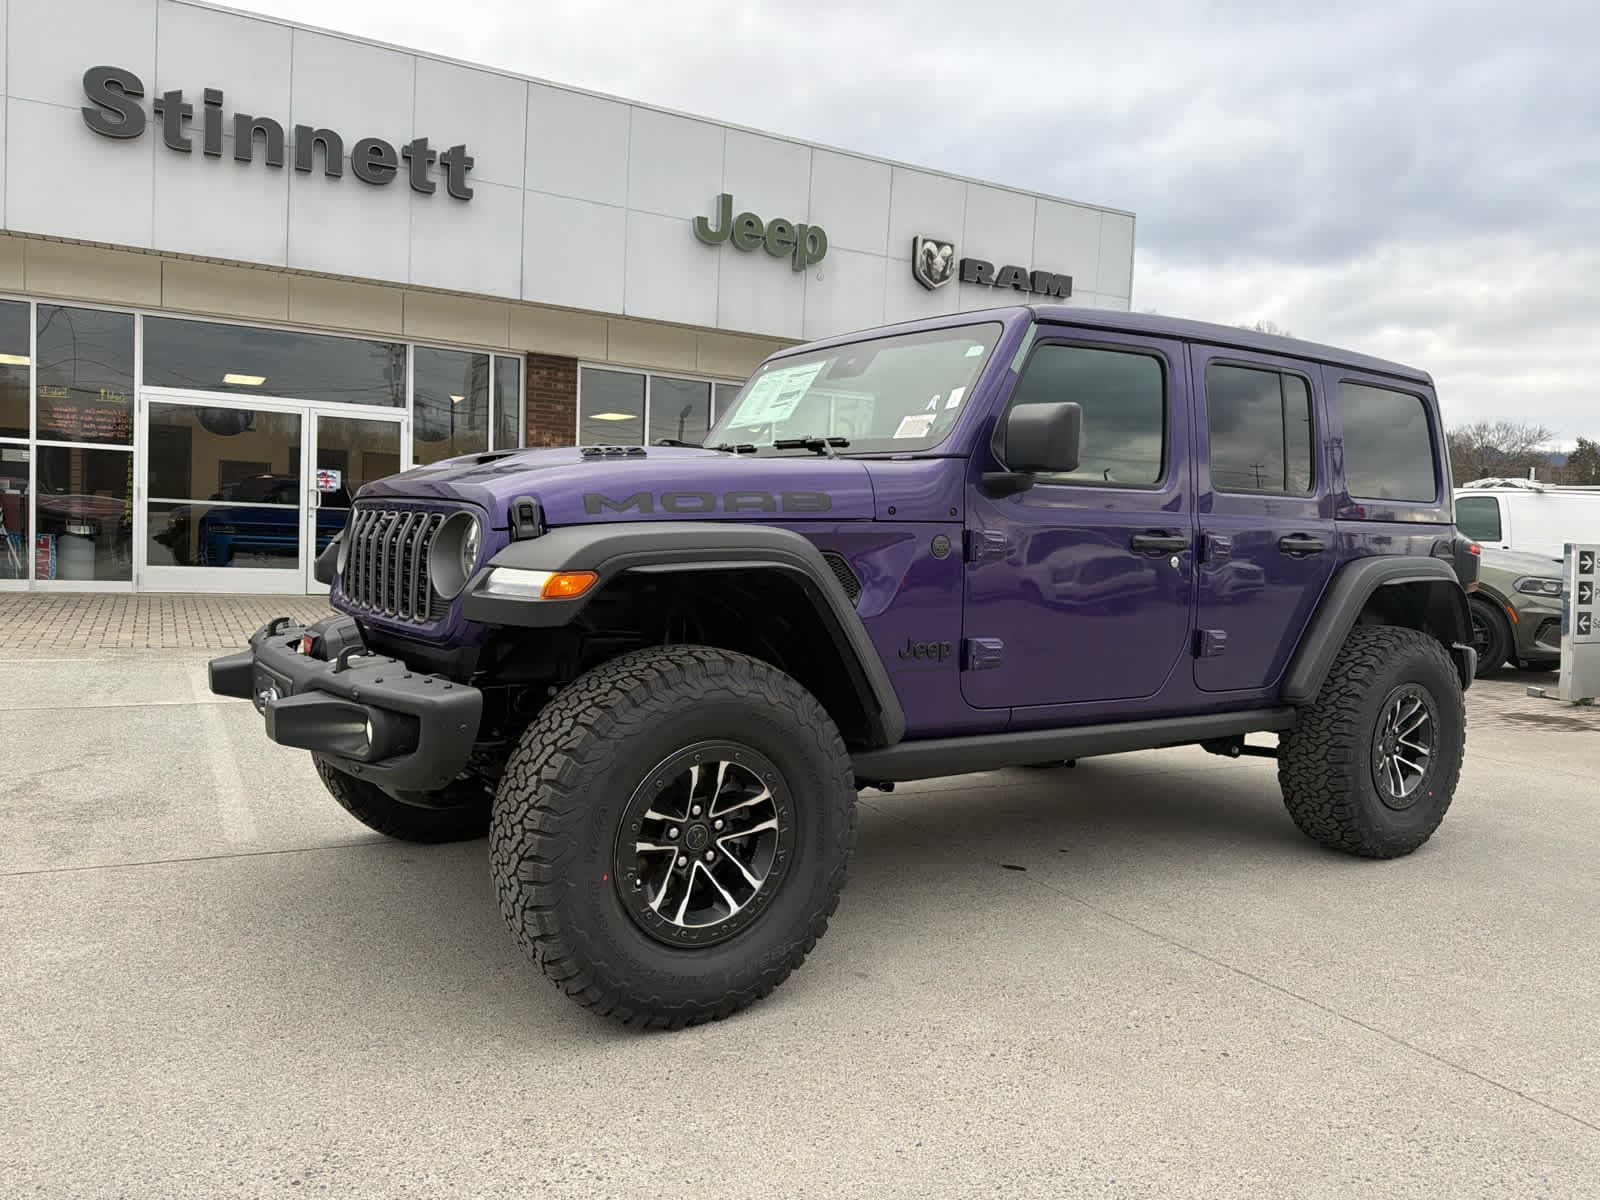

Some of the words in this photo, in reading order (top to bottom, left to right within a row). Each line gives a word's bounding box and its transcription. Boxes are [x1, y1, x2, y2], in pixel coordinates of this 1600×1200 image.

[81, 65, 474, 200] Stinnett
[692, 193, 828, 272] Jeep
[959, 257, 1073, 299] RAM
[583, 491, 832, 515] MOAB
[898, 637, 953, 662] Jeep
